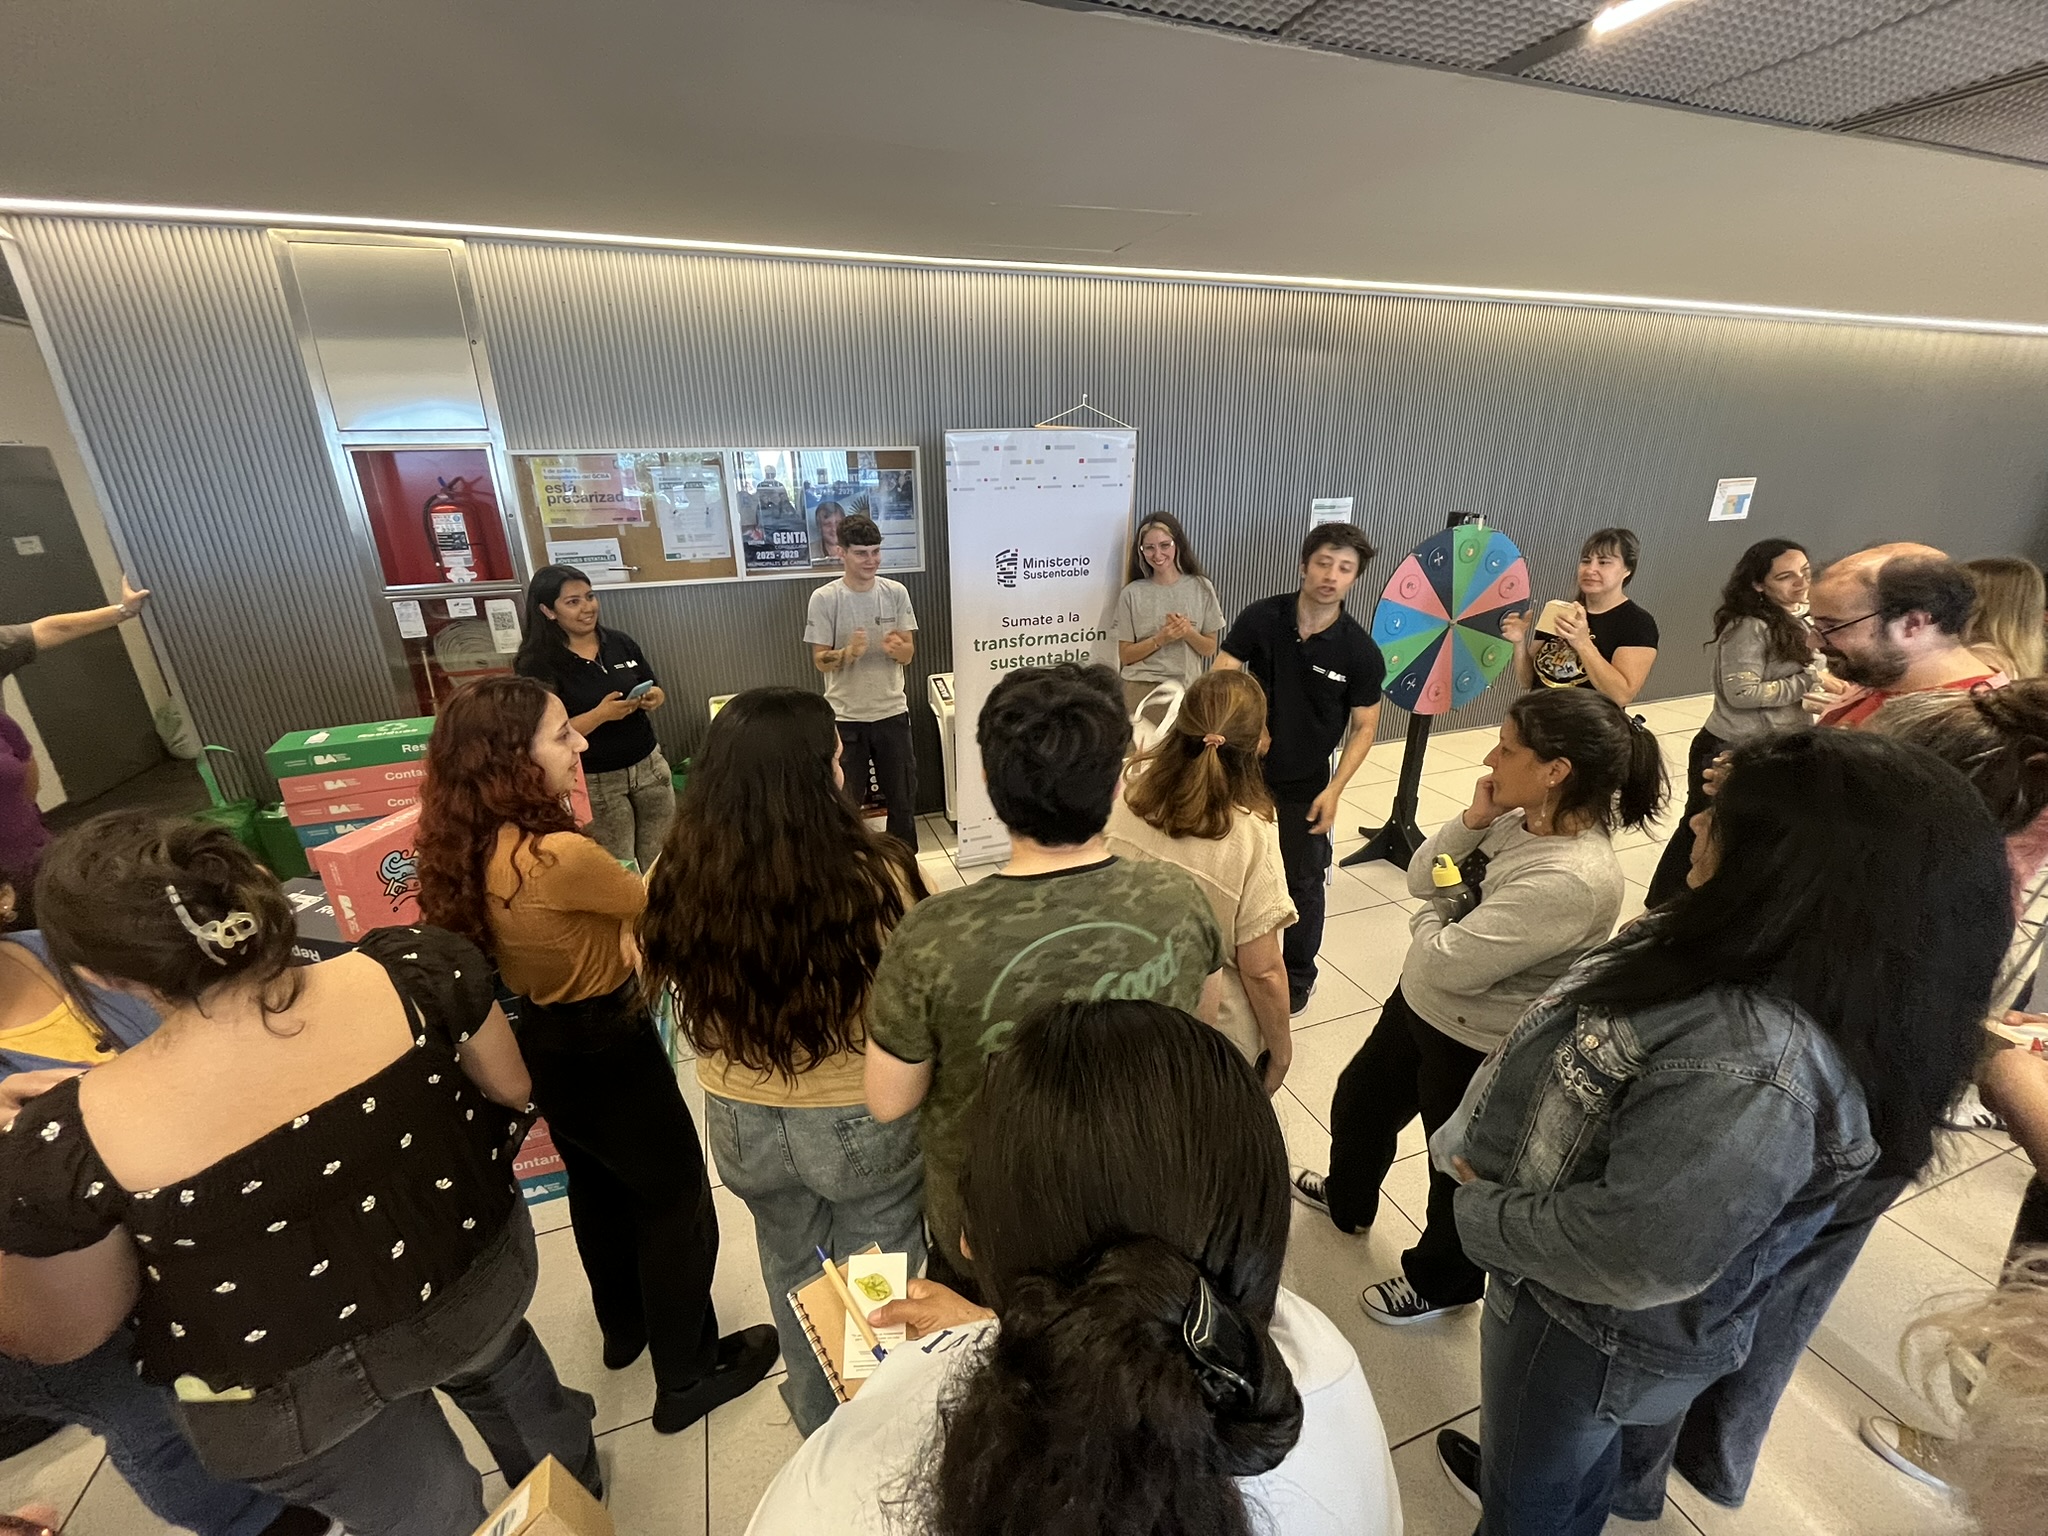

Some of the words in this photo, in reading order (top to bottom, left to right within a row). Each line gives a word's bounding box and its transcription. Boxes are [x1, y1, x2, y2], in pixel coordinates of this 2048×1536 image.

[547, 490, 631, 506] precarizad
[773, 531, 807, 545] GENTA
[756, 551, 776, 560] 2025
[1023, 555, 1091, 569] Ministerio
[1023, 567, 1090, 580] Sustentable
[1001, 614, 1053, 628] Sumate
[1056, 614, 1064, 623] a
[1068, 611, 1080, 623] la
[973, 627, 1107, 652] transformación
[989, 648, 1090, 670] sustentable
